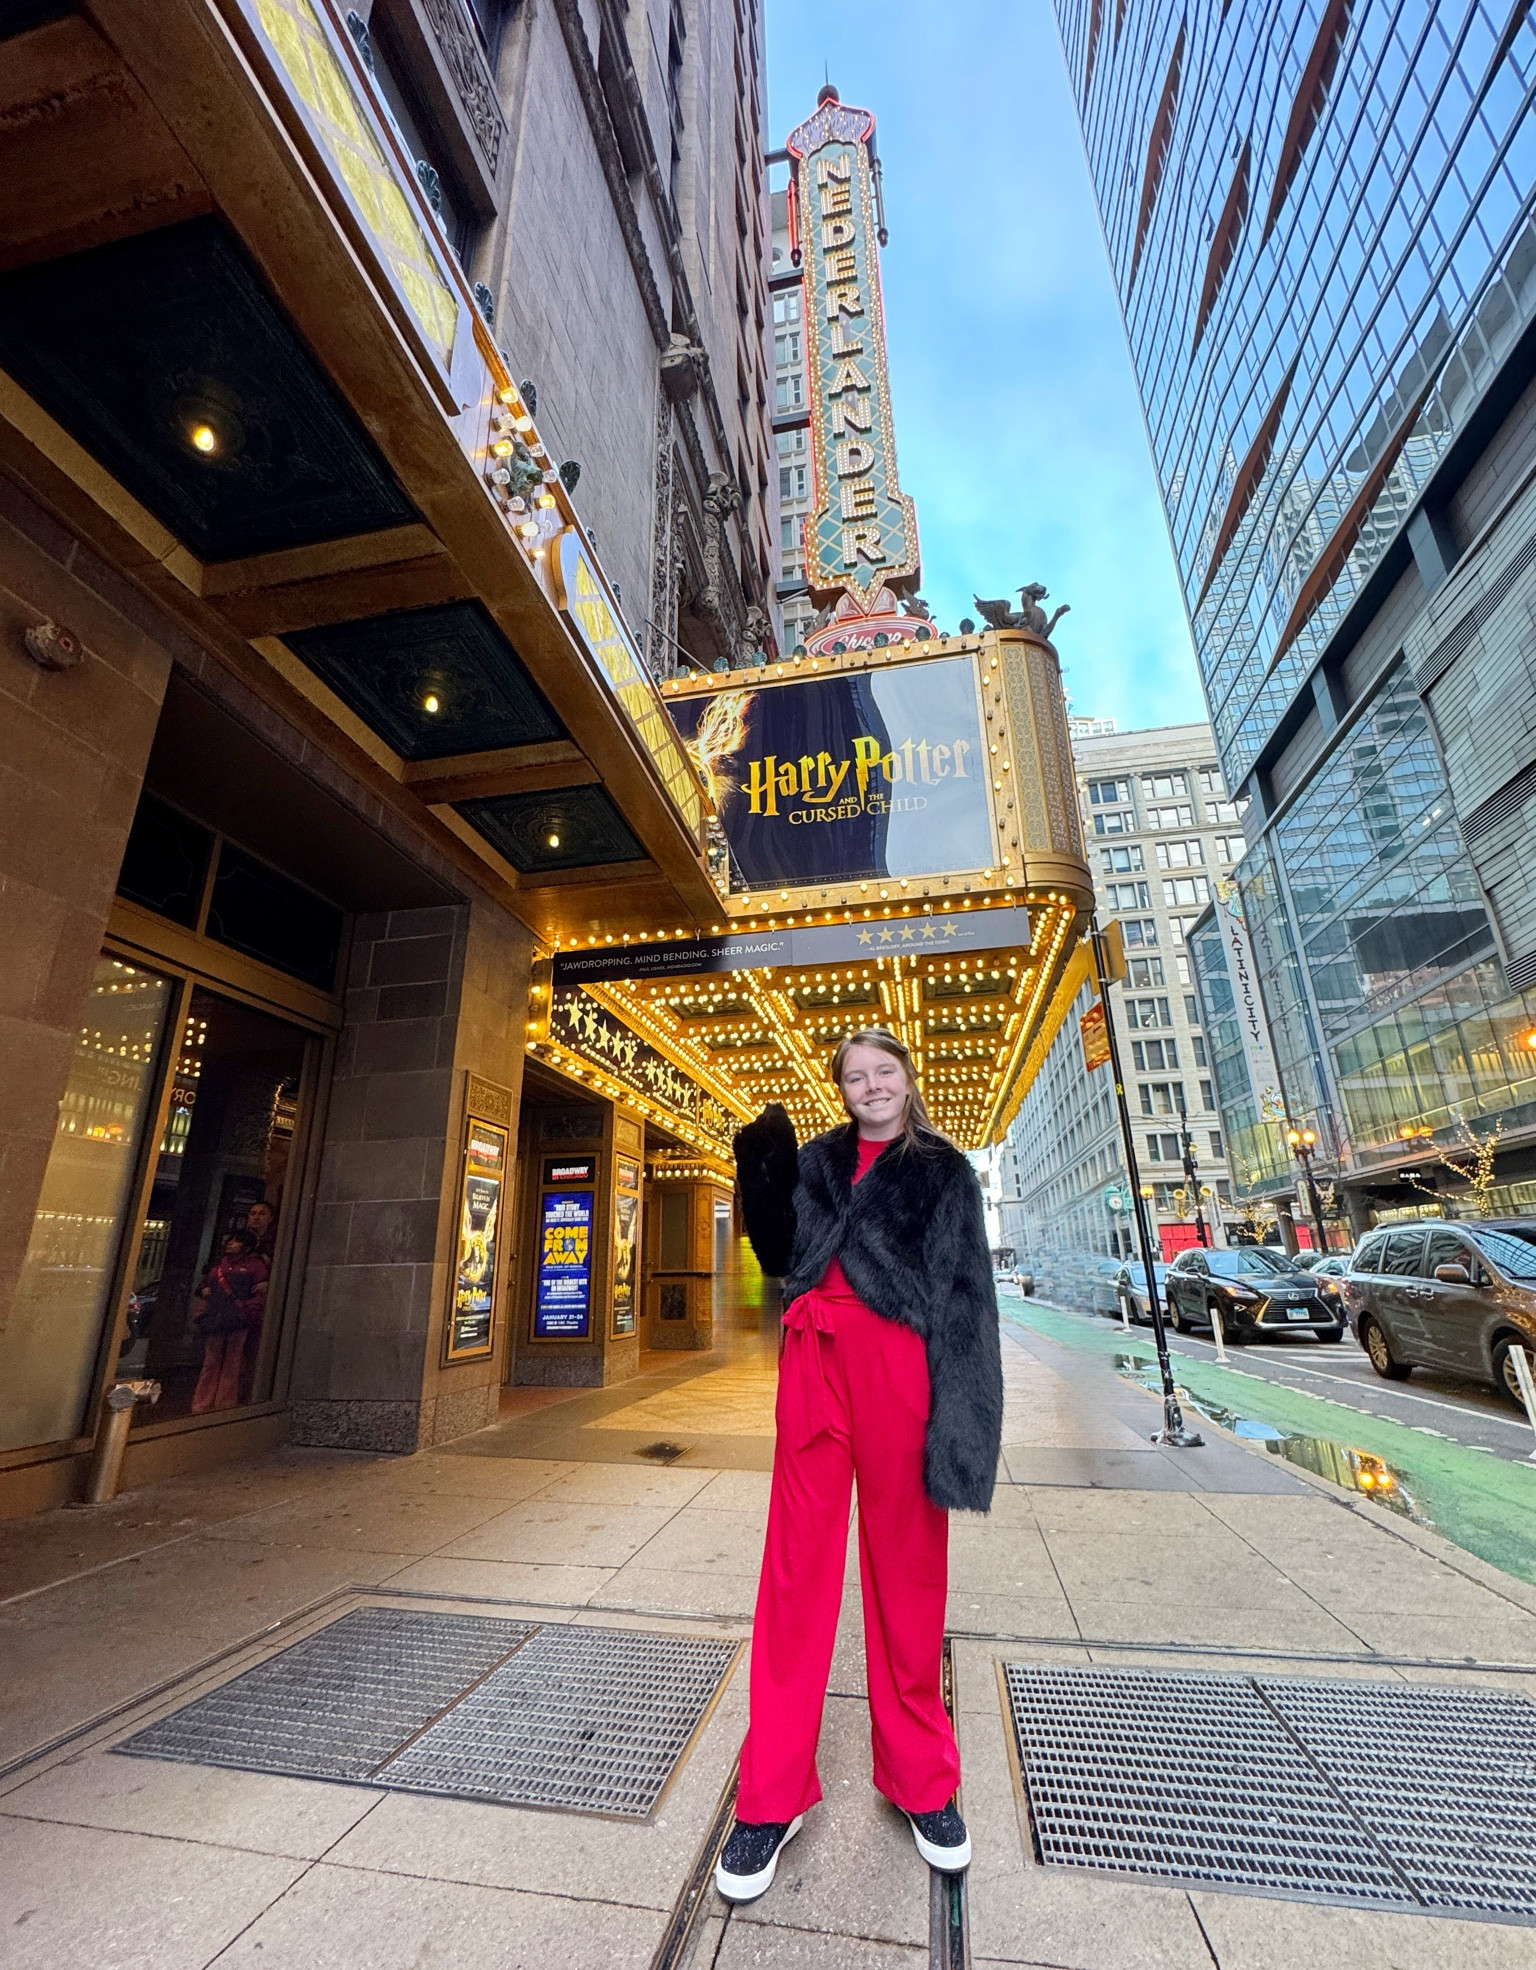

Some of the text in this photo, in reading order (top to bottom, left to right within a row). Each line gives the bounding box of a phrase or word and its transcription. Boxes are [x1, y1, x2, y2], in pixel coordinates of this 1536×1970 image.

[816, 153, 886, 568] NEDERLANDER
[741, 736, 971, 817] Harry Potter
[839, 793, 884, 805] AND THE
[788, 796, 928, 825] CURSED CHILD
[634, 954, 661, 965] MIND
[662, 949, 710, 962] BENDING.
[711, 946, 743, 958] SHEER
[1230, 925, 1262, 1042] LATINICITY
[551, 1166, 589, 1176] BROADWAY
[545, 1226, 588, 1240] COME
[543, 1251, 588, 1265] AWAY
